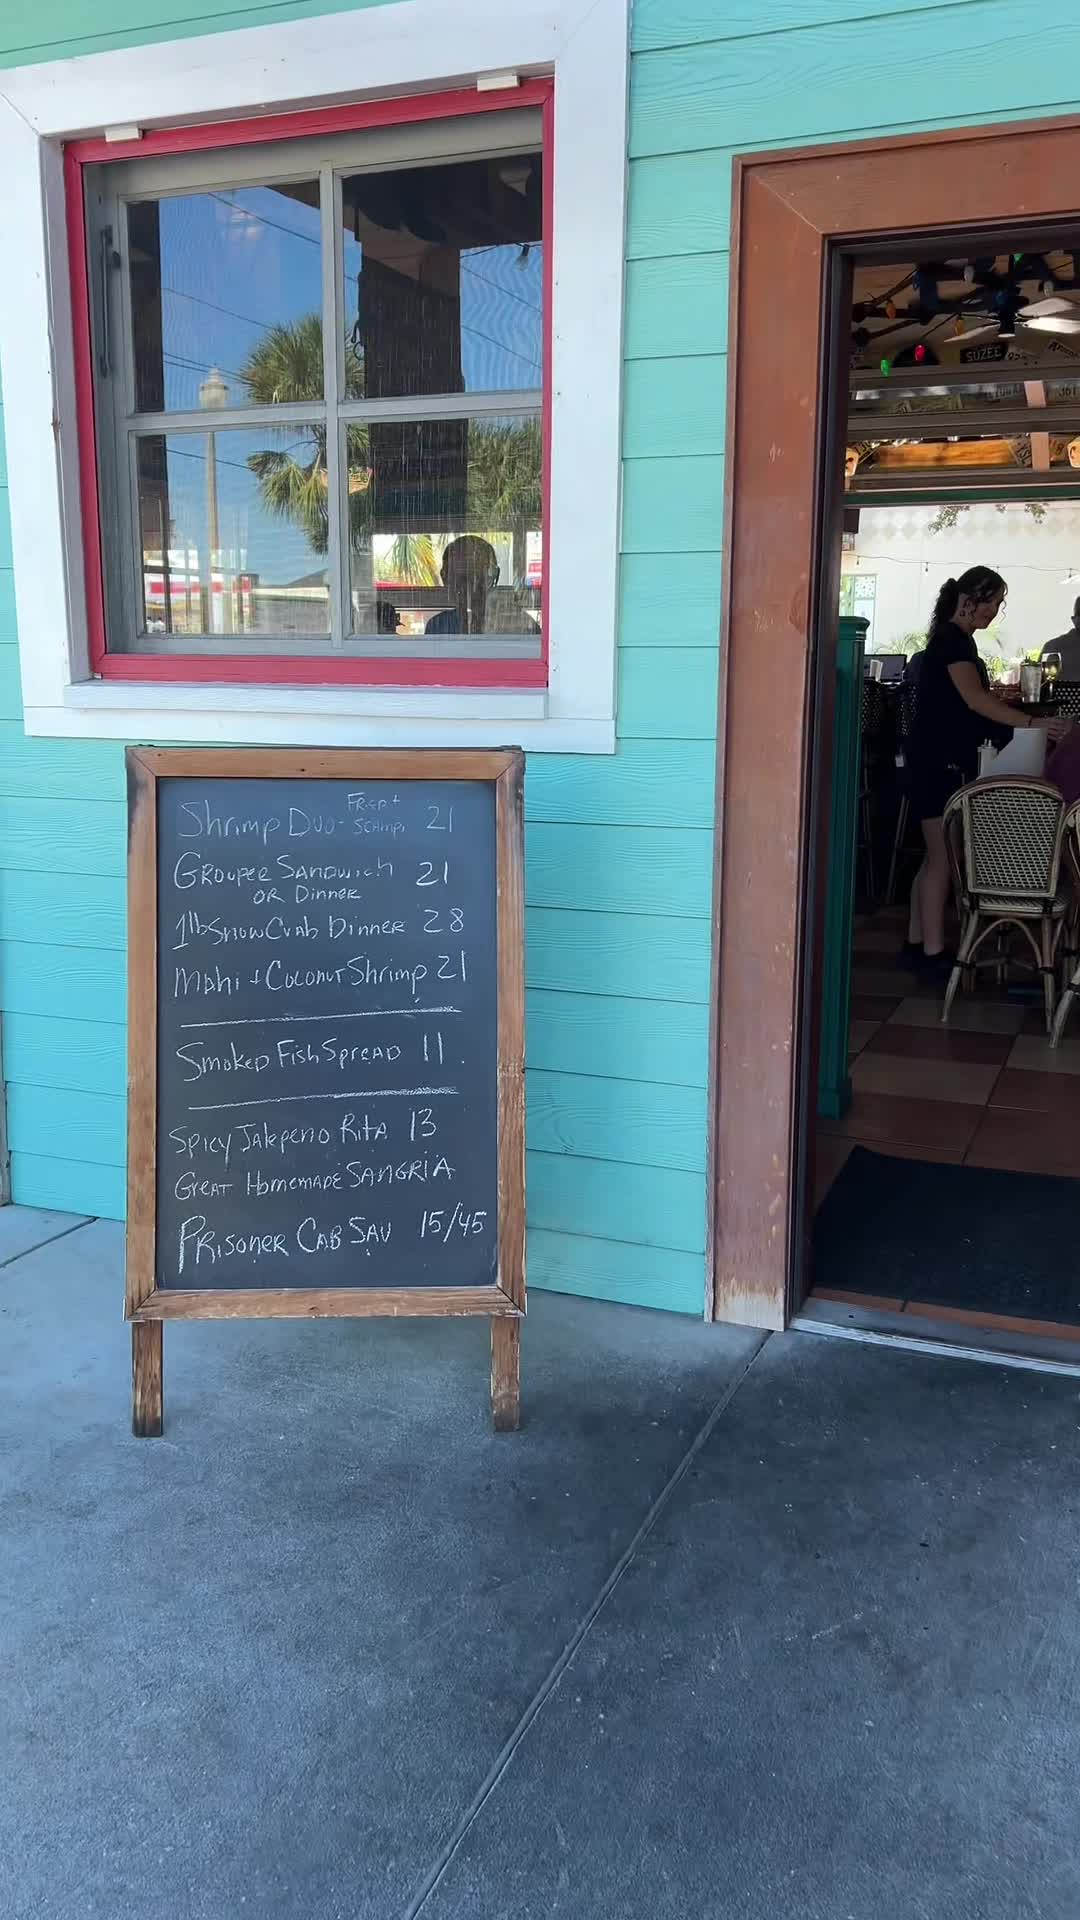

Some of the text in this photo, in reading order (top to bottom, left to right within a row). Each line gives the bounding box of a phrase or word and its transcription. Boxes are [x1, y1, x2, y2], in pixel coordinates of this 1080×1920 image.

[177, 800, 281, 845] Shrimp
[426, 806, 452, 833] 21
[416, 861, 448, 886] 21
[423, 908, 464, 933] 28
[346, 955, 428, 995] Shrimp
[437, 950, 466, 982] 21
[277, 1039, 319, 1068] Fish
[424, 1032, 443, 1065] 11
[168, 1125, 232, 1170] Spicy
[409, 1108, 437, 1141] 13
[420, 1202, 487, 1243] 15/45
